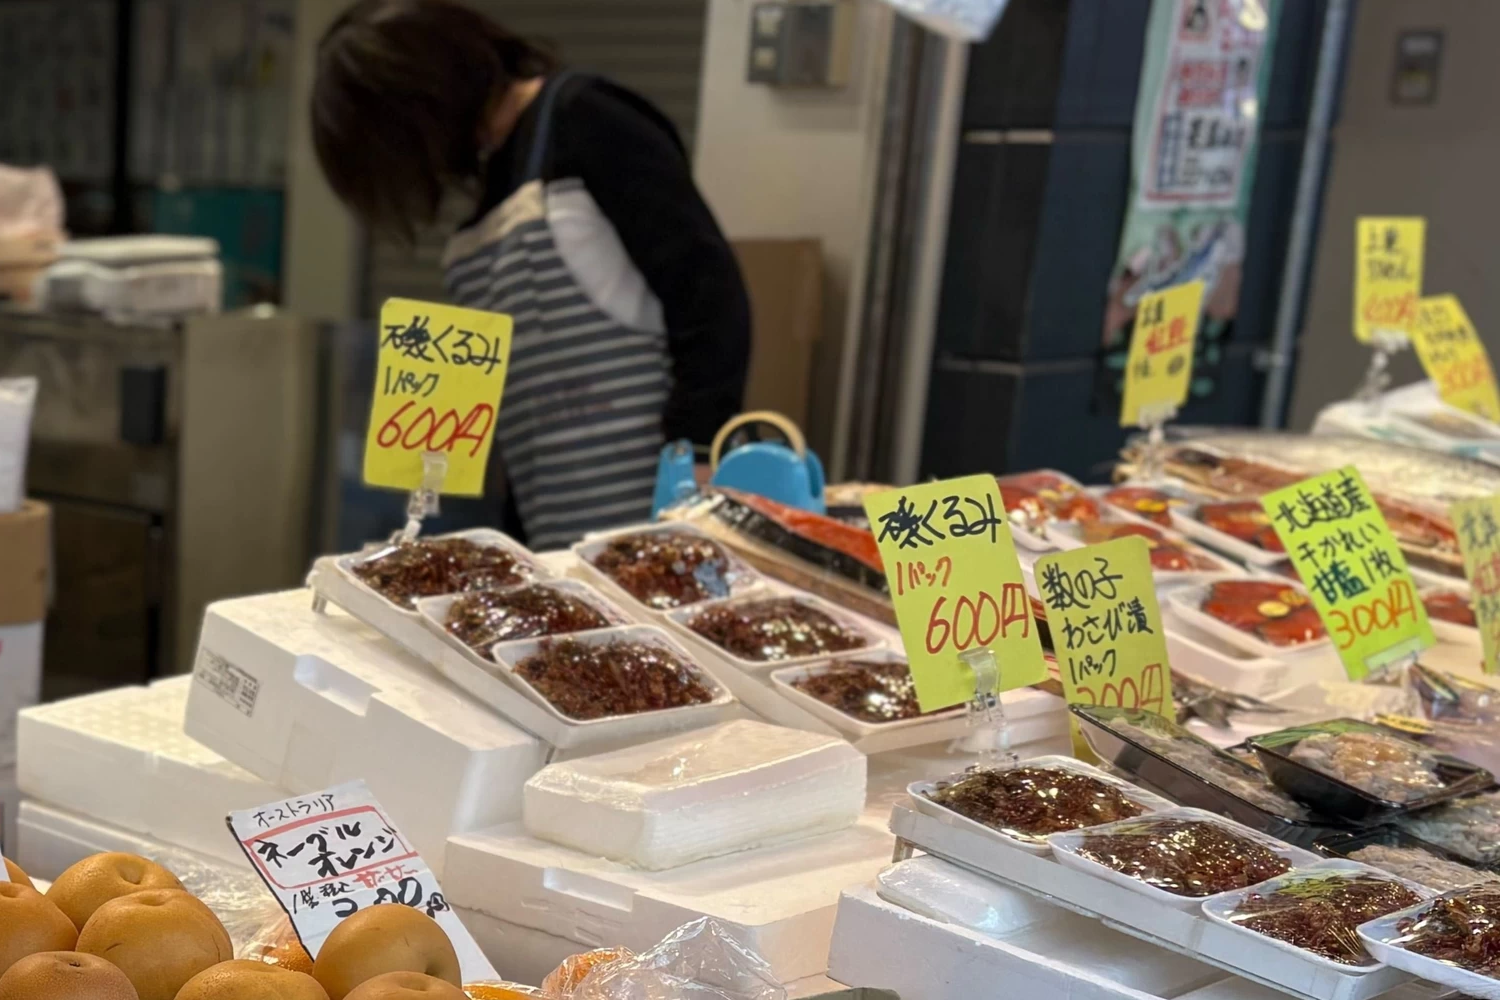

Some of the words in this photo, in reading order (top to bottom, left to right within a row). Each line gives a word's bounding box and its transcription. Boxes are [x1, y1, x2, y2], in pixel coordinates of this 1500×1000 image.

[381, 316, 501, 375] 磯くるみ
[376, 400, 494, 458] 600円
[877, 493, 1002, 549] 磯くるみ
[1275, 470, 1371, 534] 北海道産
[896, 556, 952, 596] 1パック
[1041, 557, 1123, 611] 数の子
[926, 582, 1029, 655] 600円
[1062, 596, 1154, 650] わさび漬
[1328, 579, 1419, 650] 300円
[1068, 649, 1116, 685] 1パック
[253, 794, 335, 829] オーストラリア
[256, 821, 362, 868] ネーブル
[308, 828, 397, 877] オレンジ
